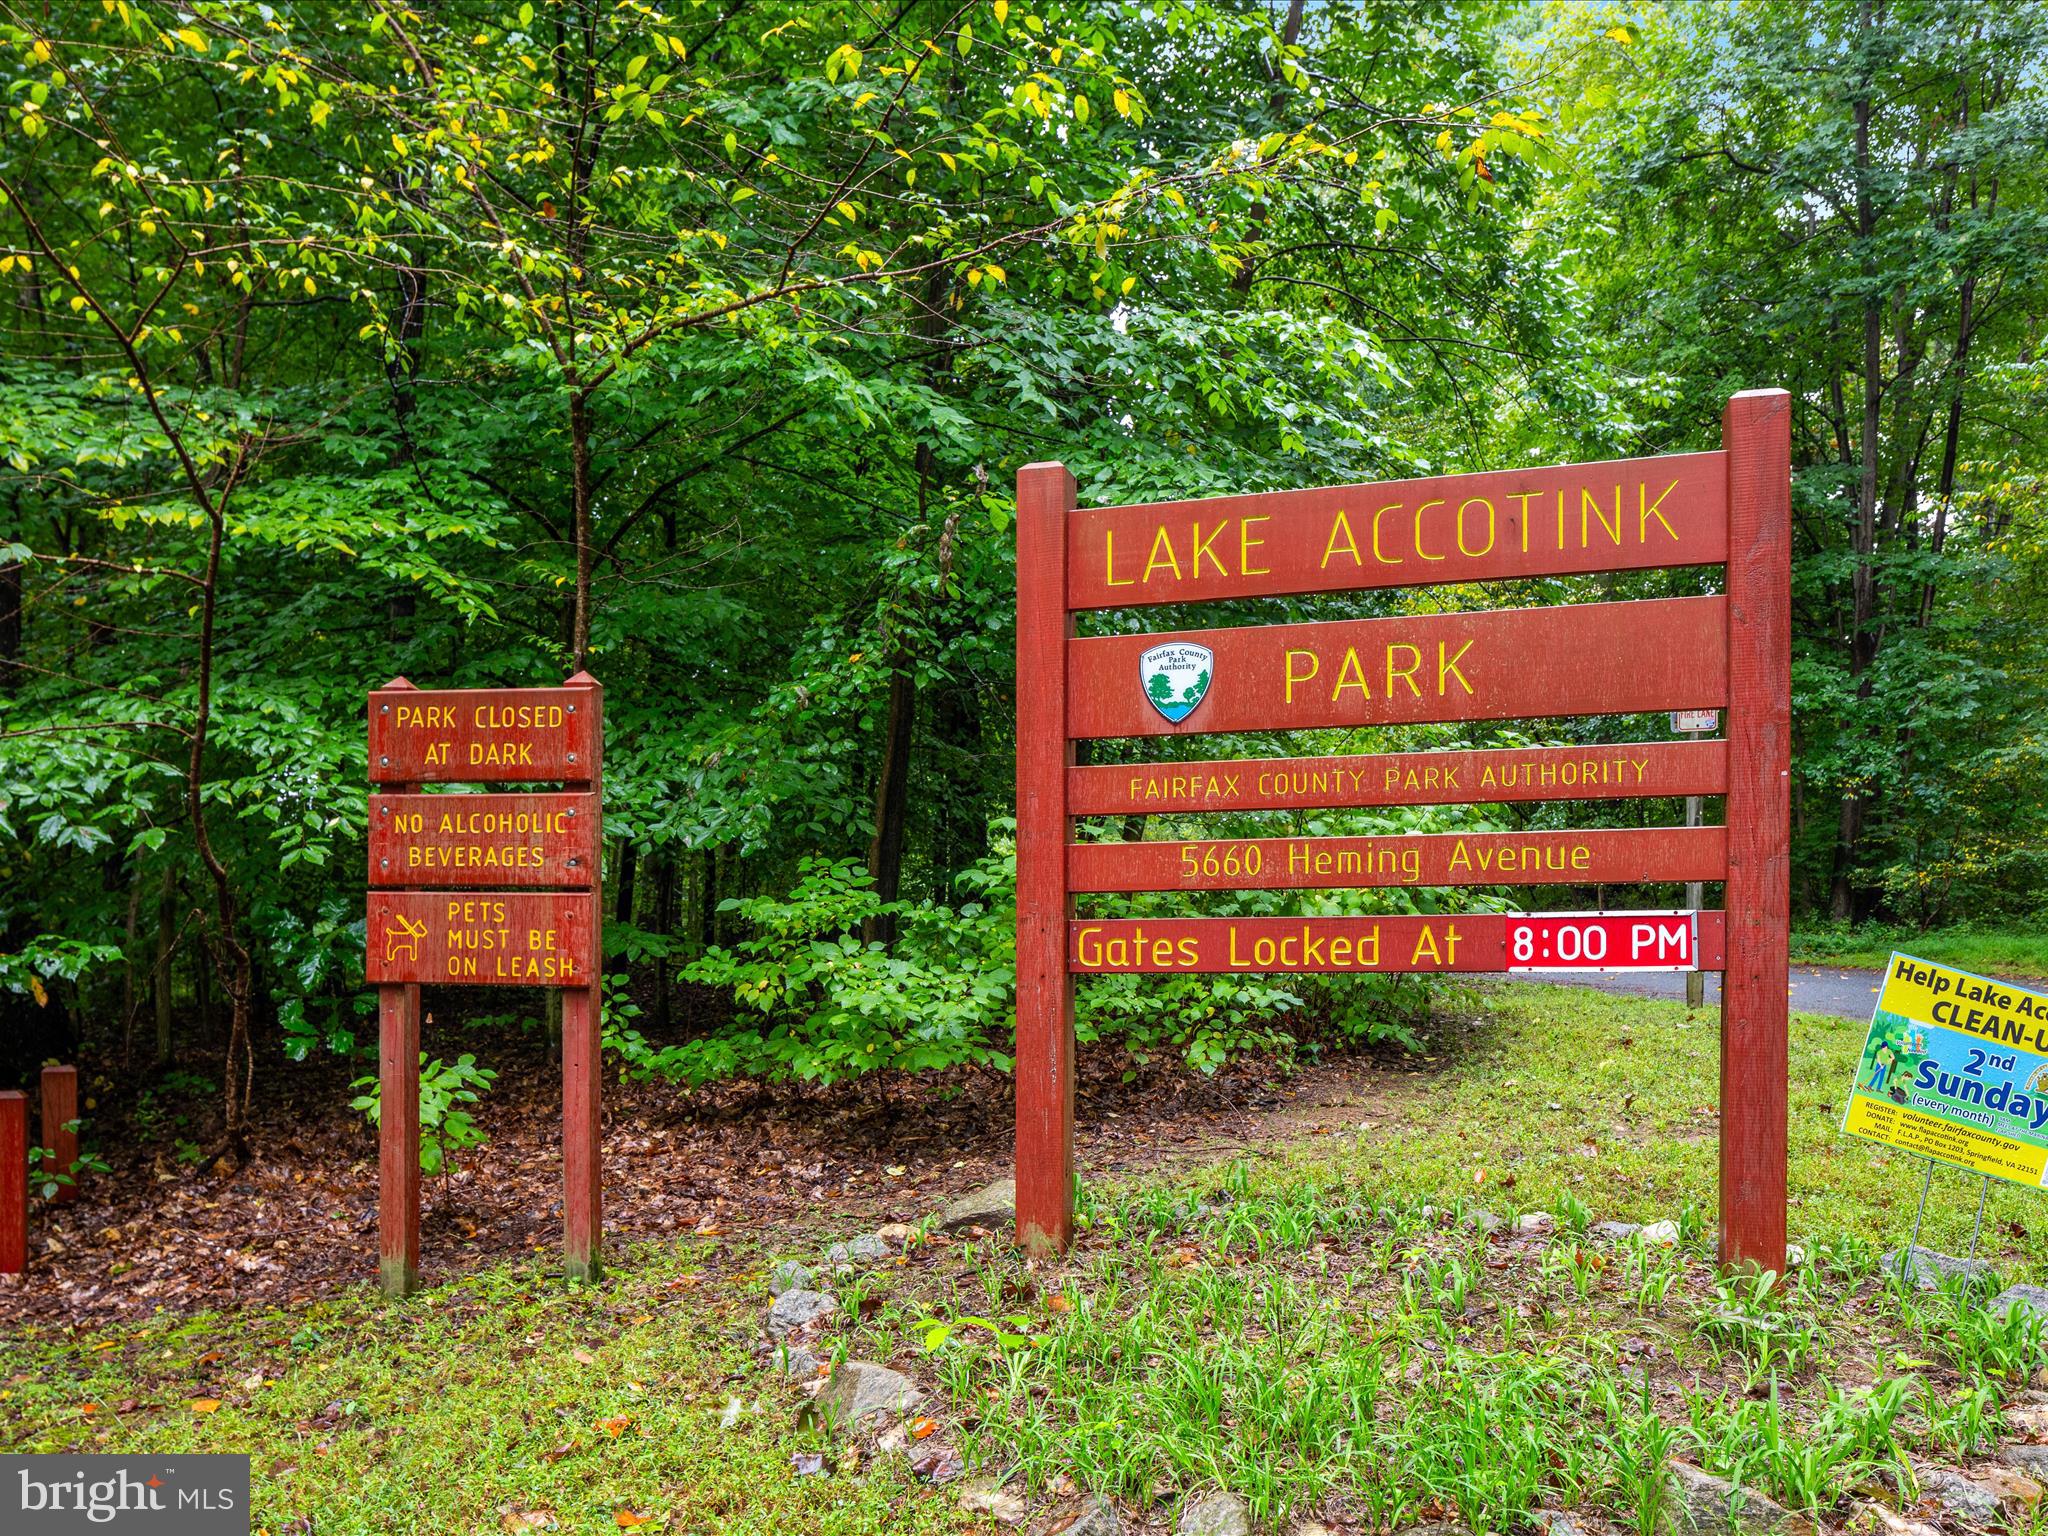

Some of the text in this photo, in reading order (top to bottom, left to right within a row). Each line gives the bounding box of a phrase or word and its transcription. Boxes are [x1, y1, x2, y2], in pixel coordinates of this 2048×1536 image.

[1106, 478, 1680, 586] LAKE ACCOTINK
[1148, 649, 1208, 662] Fairfax County
[1284, 639, 1475, 704] PARK
[396, 705, 562, 728] PARK CLOSED
[424, 743, 533, 765] AT DARK
[1131, 759, 1649, 800] FAIRFAX COUNTY PARK AUTHORITY
[395, 812, 566, 834] NO ALCOHOLIC
[409, 846, 544, 867] BEVERAGES
[1181, 839, 1590, 882] 5660 Heming Avenue
[448, 902, 505, 923] PETS
[448, 930, 557, 950] MUST BE
[1078, 922, 1687, 967] Gates Locked At 8:00 PM
[448, 956, 573, 978] ON LEASH
[1895, 961, 2048, 1021] Help Lake Ac
[1963, 1049, 2016, 1076] 2nd
[1913, 1093, 1994, 1127] (every month)
[1914, 1061, 2048, 1129] Sunday
[1858, 1127, 1890, 1141] CONTACT:
[1866, 1102, 1897, 1115] REGISTER:
[1903, 1113, 2020, 1151] volunteer.fairfaxcounty.gov
[1866, 1111, 1969, 1147] DONATE: www.flapaccotink.org
[1874, 1123, 1893, 1132] MAIL:
[1935, 1140, 1946, 1148] Box
[2017, 1164, 2038, 1175] 22151
